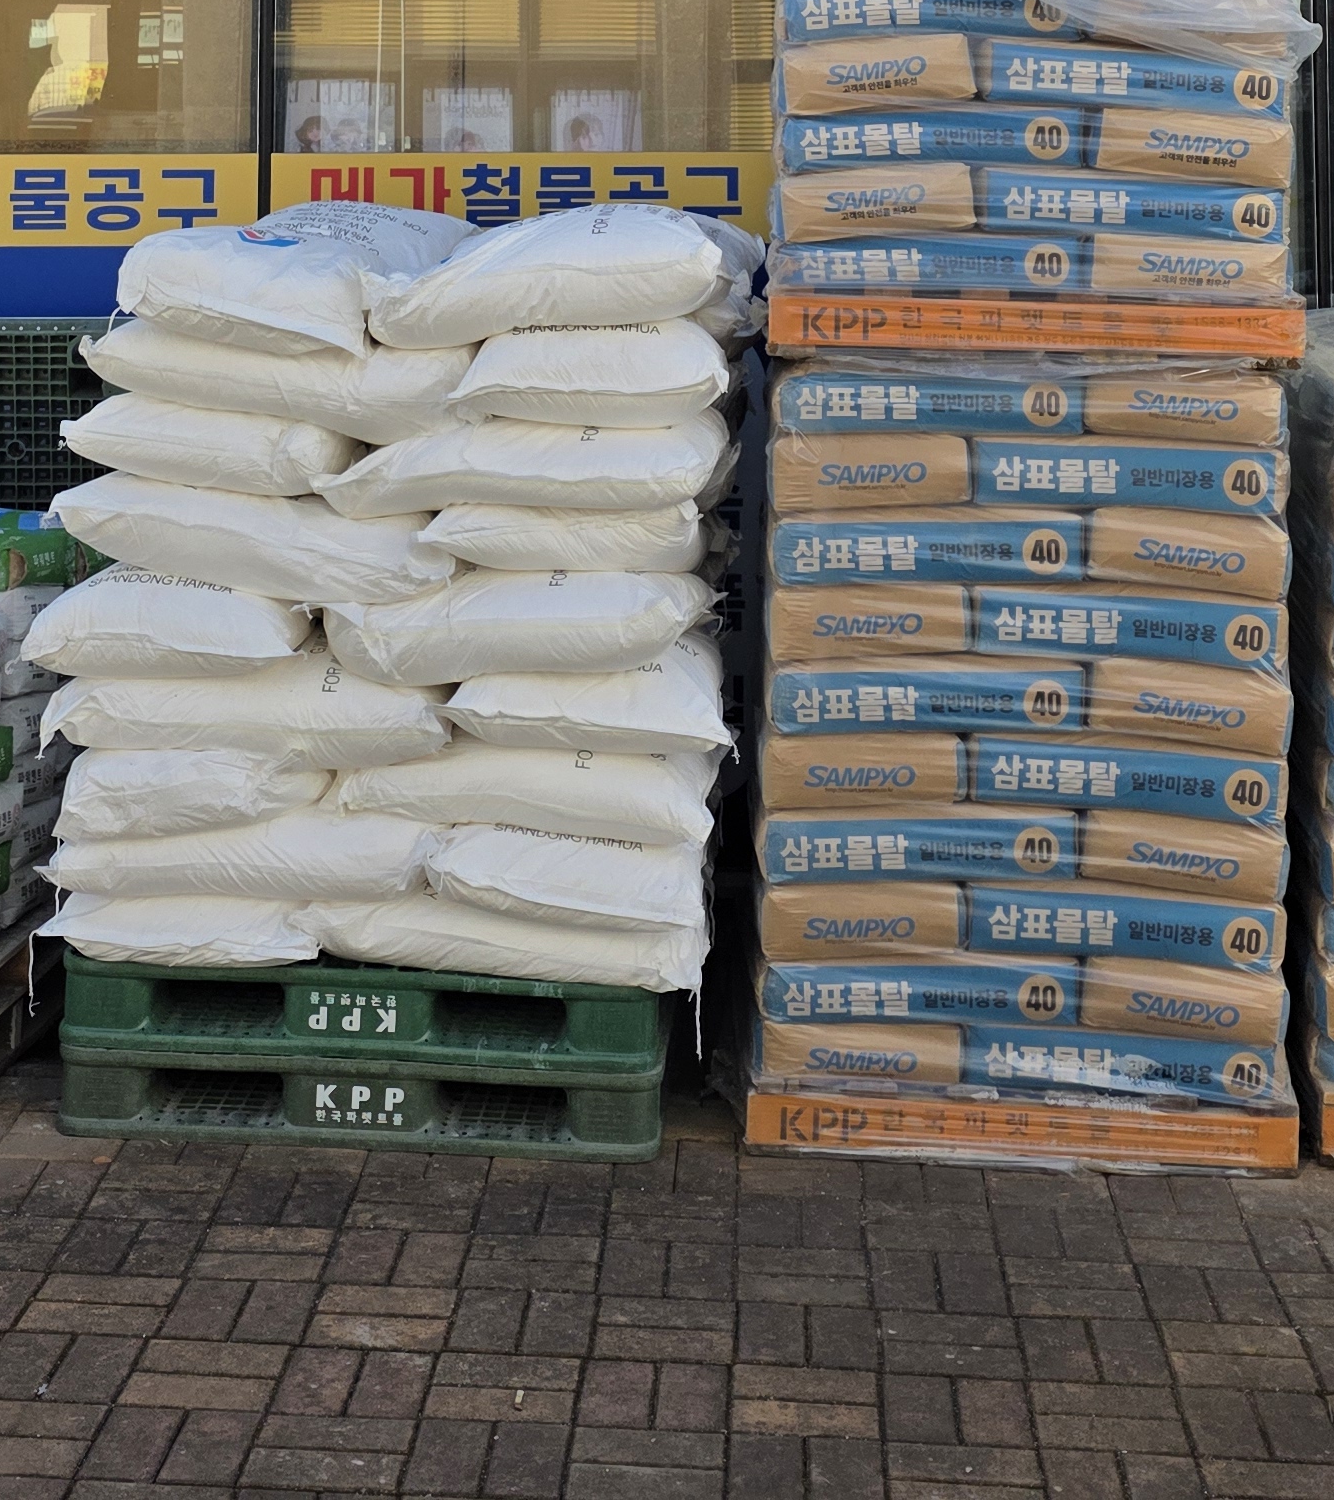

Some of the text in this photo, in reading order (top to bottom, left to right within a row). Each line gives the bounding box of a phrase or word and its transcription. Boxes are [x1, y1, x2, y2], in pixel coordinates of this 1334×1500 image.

[1006, 57, 1271, 101] 삼표몰탈 일반미장용 40
[1145, 128, 1251, 158] SAMPYO
[799, 248, 922, 282] 삼표몰탈
[1033, 252, 1062, 278] 40
[1138, 252, 1244, 280] SAMPYO
[802, 306, 887, 340] KPP
[818, 462, 927, 487] SAMPYO
[991, 456, 1261, 496] 삼표몰탈 일반미장용 40
[813, 613, 923, 638] SAMPYO
[792, 685, 1062, 724] 삼표몰탈 일반미장용 40
[804, 764, 916, 790] SAMPYO
[803, 916, 916, 941] SAMPYO
[988, 904, 1261, 955] 삼표몰탈 일반미장용 40
[308, 1006, 397, 1032] KPP
[805, 1048, 918, 1075] SAMPYO
[316, 1084, 405, 1111] KPP
[779, 1106, 869, 1143] KPP
